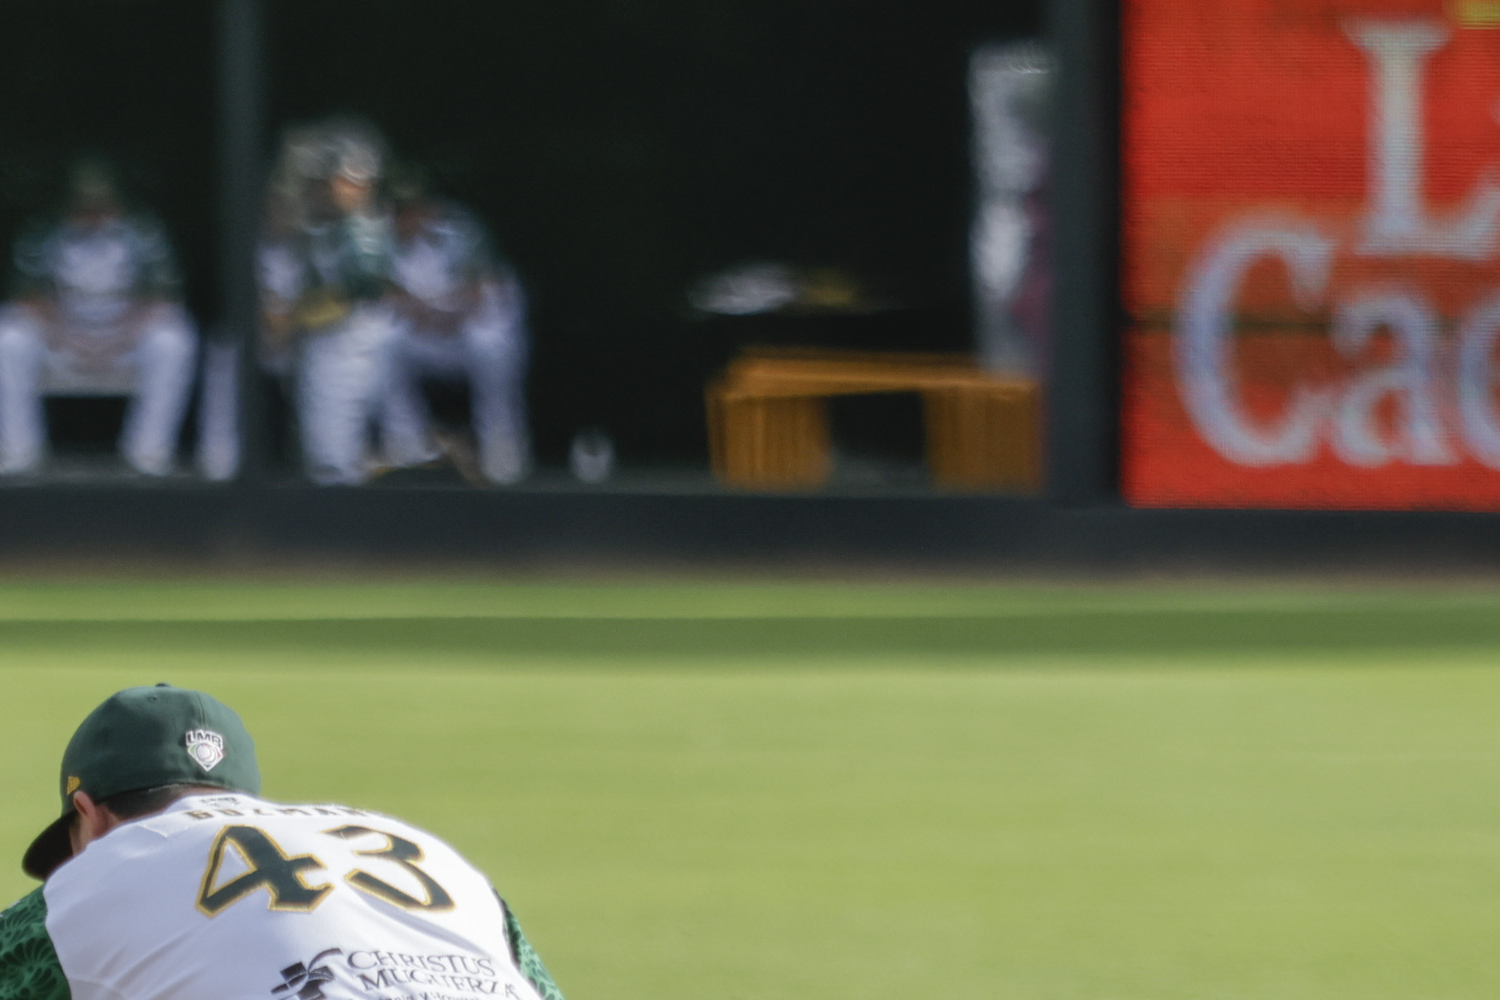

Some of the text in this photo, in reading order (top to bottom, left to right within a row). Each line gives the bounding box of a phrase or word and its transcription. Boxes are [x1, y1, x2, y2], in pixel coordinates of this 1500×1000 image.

[1338, 16, 1500, 262] L
[195, 823, 457, 918] 43
[347, 950, 497, 977] CHRISTUS
[357, 967, 522, 1000] MUGUERZA
